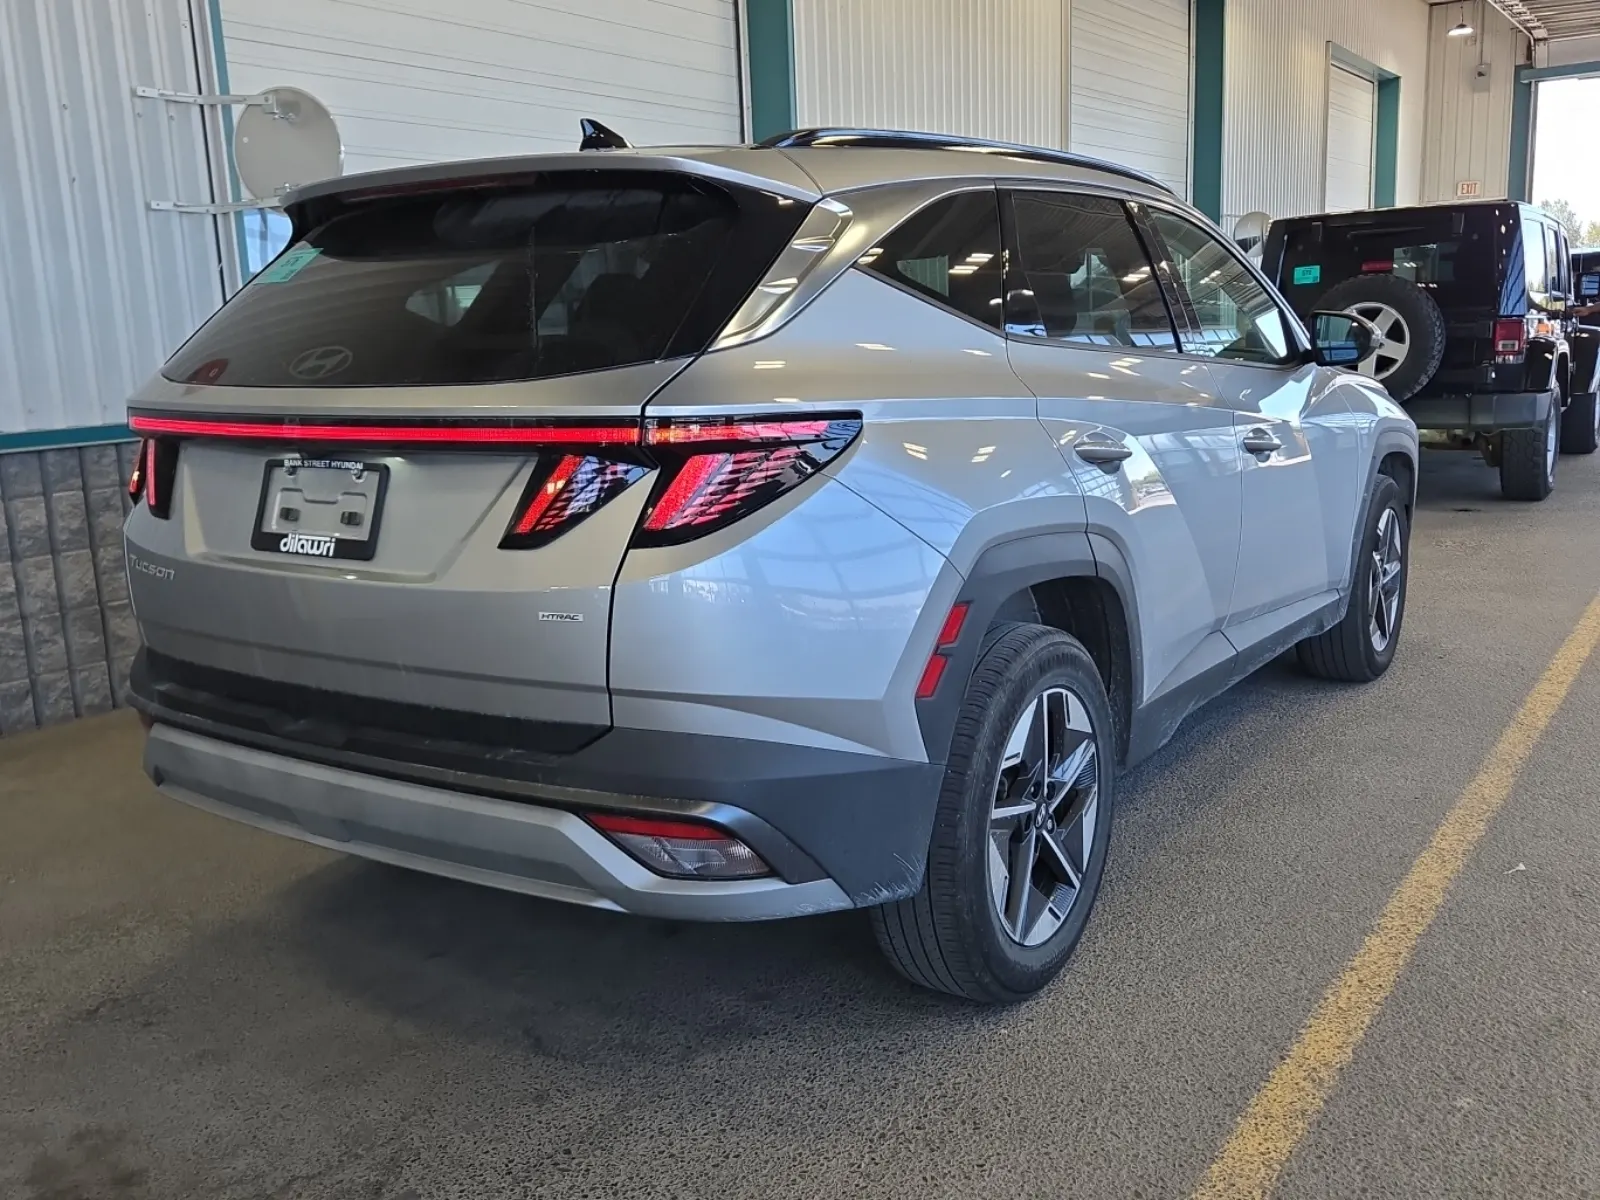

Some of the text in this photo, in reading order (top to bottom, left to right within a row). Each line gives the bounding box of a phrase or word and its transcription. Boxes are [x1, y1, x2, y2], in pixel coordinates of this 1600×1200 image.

[1461, 183, 1478, 195] EXIT
[284, 459, 364, 470] BANK STREET HYUNDAI
[280, 533, 336, 557] dilawri
[541, 613, 580, 621] HTRAC
